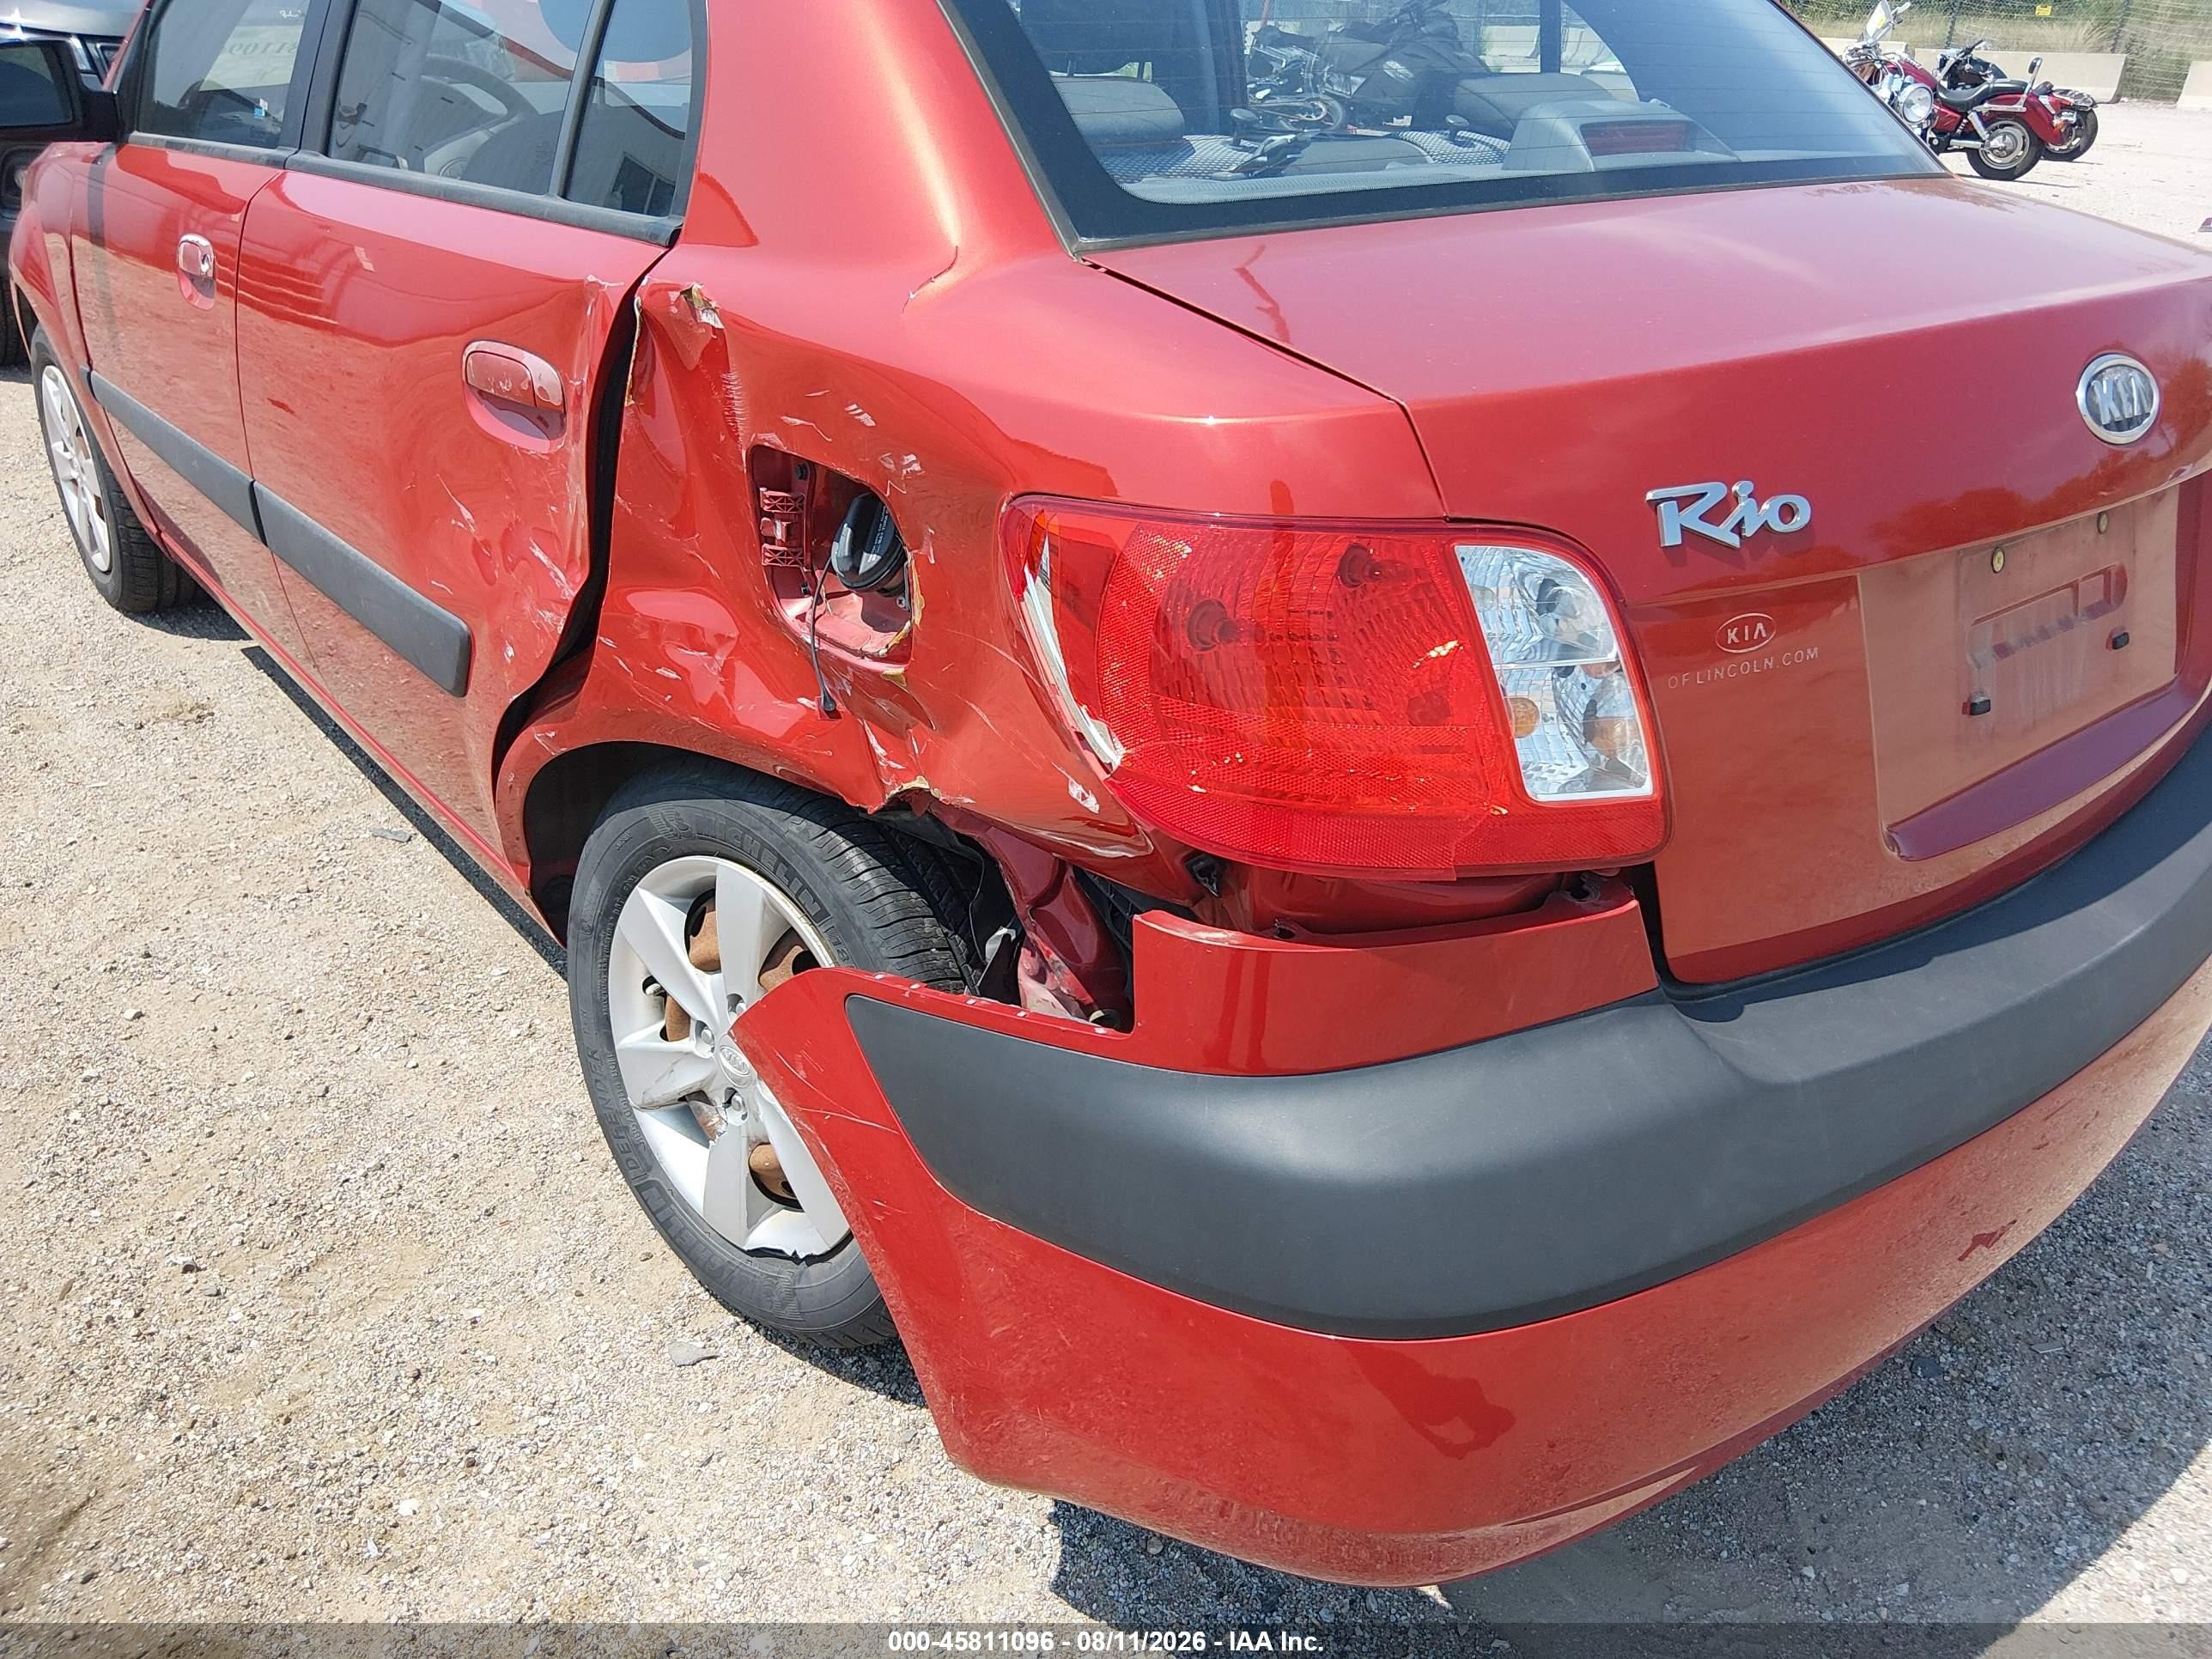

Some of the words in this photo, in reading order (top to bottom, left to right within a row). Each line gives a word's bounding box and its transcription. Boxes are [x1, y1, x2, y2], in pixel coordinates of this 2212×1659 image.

[2091, 371, 2151, 425] KIA
[1645, 480, 1812, 550] Rio
[1726, 622, 1767, 644] KIA
[1668, 673, 1690, 689] OF
[1695, 646, 1820, 684] LINCOLN.COM
[692, 812, 822, 917] MICHELIN
